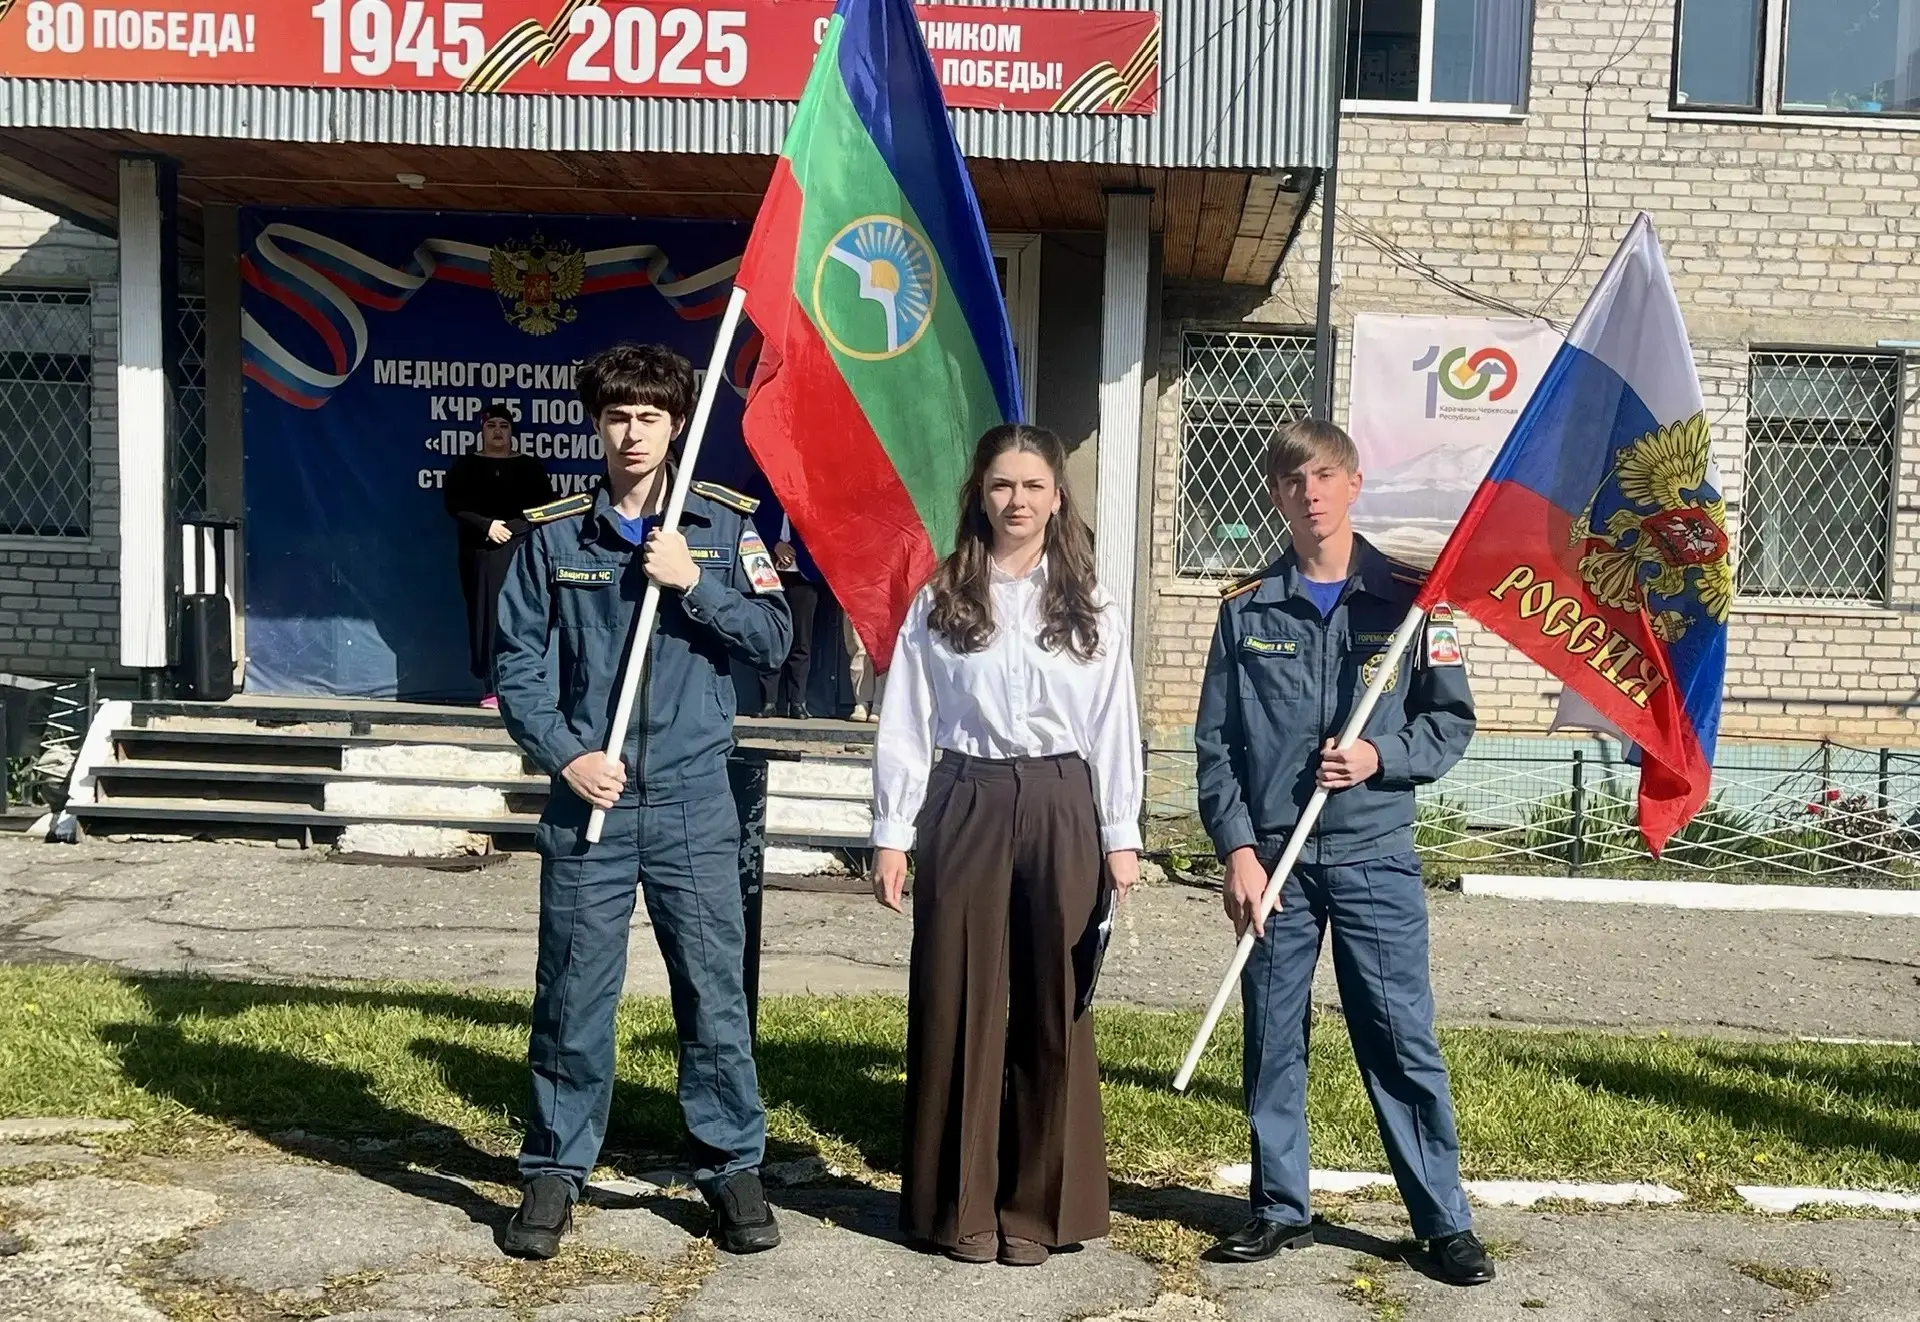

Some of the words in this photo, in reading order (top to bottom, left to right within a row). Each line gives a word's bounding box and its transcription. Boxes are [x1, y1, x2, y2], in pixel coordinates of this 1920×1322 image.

[26, 1, 84, 53] 80
[92, 10, 255, 58] ПОБЕДА!
[311, 0, 487, 78] 1945
[567, 3, 748, 87] 2025
[920, 21, 1021, 52] НИКОМ
[942, 58, 1063, 93] ПОБЕДЫ!
[431, 396, 482, 421] КЧР
[532, 398, 584, 424] ПОО
[599, 571, 611, 580] ЧС
[1284, 642, 1296, 651] ЧС
[1490, 566, 1667, 708] РОССИЯ
